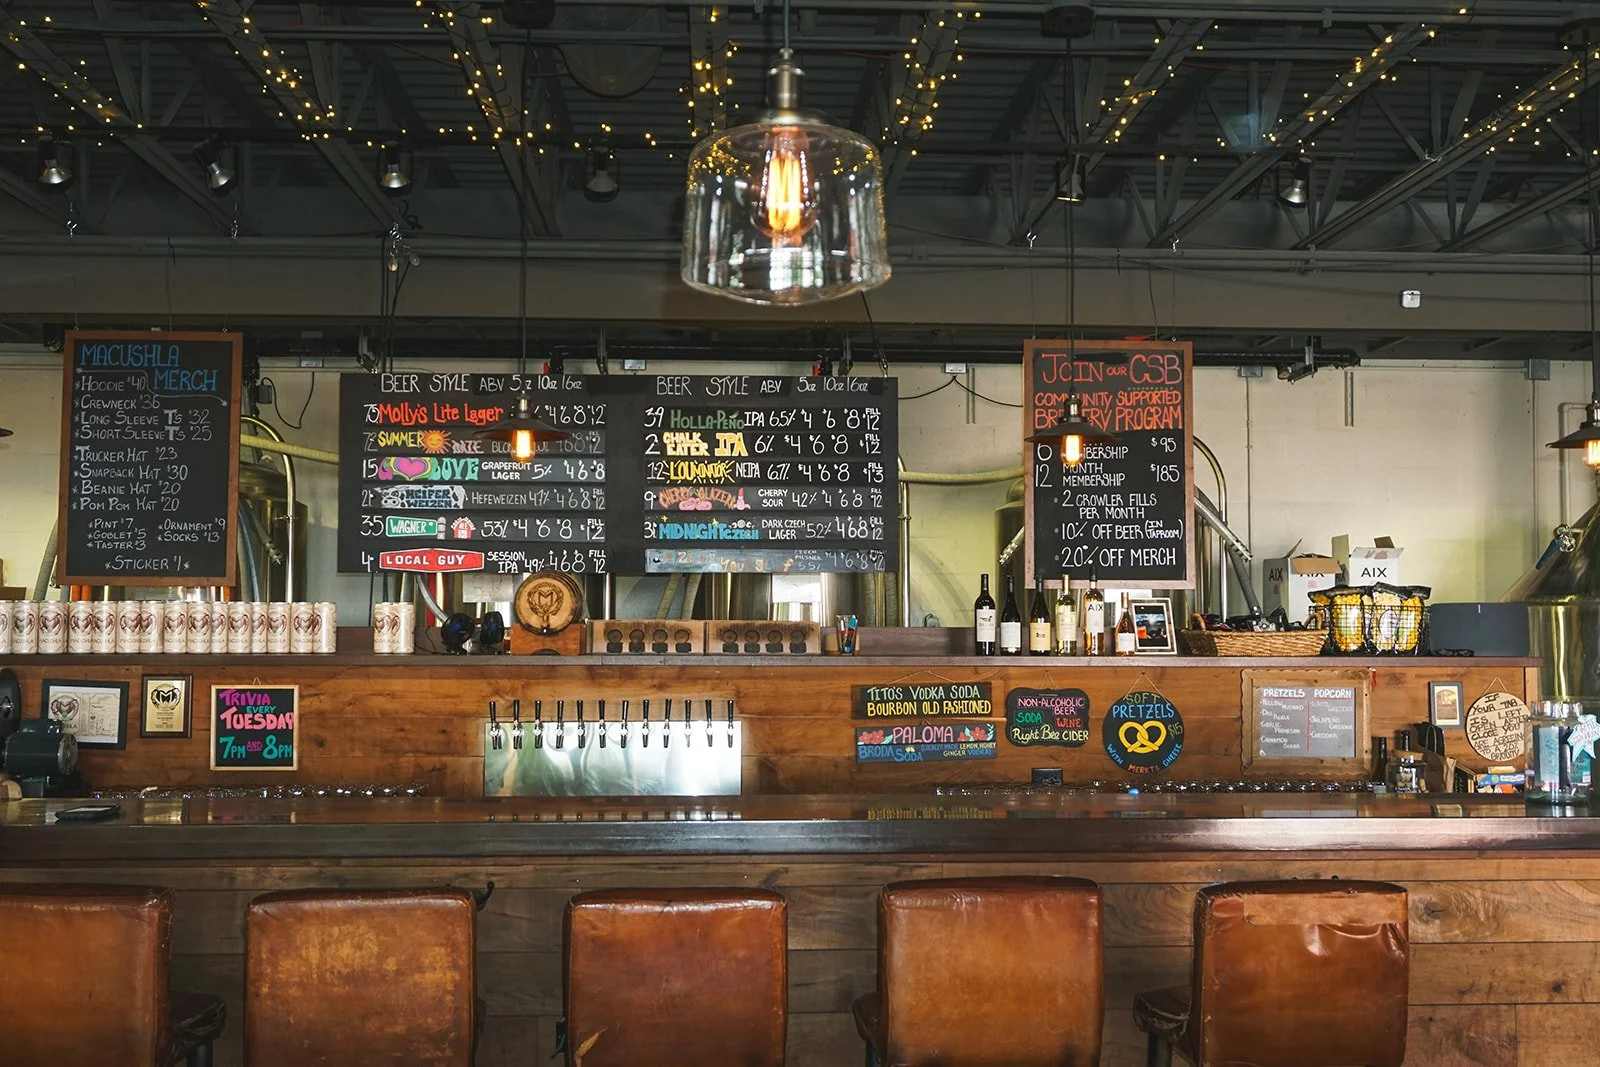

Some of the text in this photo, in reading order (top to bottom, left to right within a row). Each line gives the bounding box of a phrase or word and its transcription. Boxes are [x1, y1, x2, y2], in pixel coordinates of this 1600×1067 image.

[80, 344, 179, 367] MACUSHLA
[1042, 354, 1182, 384] JOIN OUR CSB
[81, 376, 145, 391] HOODIE $40
[153, 369, 217, 391] MERCH
[382, 374, 420, 392] BEER
[430, 373, 469, 392] STYLE
[480, 377, 504, 391] ABV
[657, 376, 692, 395] BEER
[706, 376, 749, 396] STYLE
[760, 380, 781, 393] ABV
[81, 394, 160, 409] CREWNECK $36
[1116, 391, 1181, 406] SUPPORTED
[81, 413, 110, 424] LONG
[115, 411, 159, 424] SLEEVE
[433, 403, 459, 423] Lite
[464, 402, 504, 426] Lager
[744, 412, 764, 427] IPA
[1116, 406, 1182, 431] PROGRAM
[80, 425, 122, 440] SHORT
[122, 427, 165, 440] SLEEVE
[378, 431, 424, 447] SUMMER
[663, 432, 774, 456] CHALK IPA 6%
[667, 443, 710, 456] EATER
[1151, 437, 1176, 453] $95
[75, 446, 124, 462] TRUCKER
[127, 449, 148, 461] HAT
[80, 464, 188, 479] SNAPBACK HAT $30
[482, 462, 531, 470] GRAPEFRUIT
[736, 463, 760, 478] NEIPA
[492, 471, 520, 479] LAGER
[1036, 463, 1179, 487] 12 MONTH $185
[1063, 473, 1125, 486] MEMBERSHIP
[81, 481, 181, 494] BEANIE HAT $20
[406, 489, 526, 504] HEIFER HEFEWEIZEN
[1062, 490, 1157, 506] 2 GROWLER FILLS
[80, 498, 179, 511] POM POM HAT $20
[1080, 508, 1144, 519] PER MONTH
[94, 519, 117, 529] PINT
[163, 519, 212, 531] ORNAMENT
[390, 519, 426, 533] WAGNER
[659, 520, 806, 539] MIDNIGHT CZECH DARK CZECH
[1062, 522, 1143, 539] 10% OFF BEER
[93, 531, 131, 539] GOBLET
[164, 532, 198, 541] SOCKS
[769, 530, 796, 539] LAGER
[95, 541, 133, 549] TASTER
[112, 555, 168, 570] STICKER
[387, 551, 525, 564] LOCAL GUY SESSION
[1062, 546, 1176, 567] 20% OFF MERCH
[498, 562, 518, 573] IPA
[1269, 568, 1282, 580] AIX
[1361, 568, 1387, 577] AIX
[219, 689, 270, 705] TRIVIA
[867, 685, 980, 701] TITO'S VODKA SODA
[1126, 693, 1160, 704] SOFT
[1264, 689, 1305, 697] PRETZELS
[1314, 689, 1351, 698] POPCORN
[1485, 693, 1500, 703] IF
[868, 700, 991, 716] BOURBON OLD FASHIONED
[1018, 699, 1084, 707] NON-ALCOHOLIC
[1112, 703, 1174, 718] PRETZELS
[1473, 704, 1495, 715] YOUR
[220, 706, 294, 729] TUESDAY
[1016, 712, 1080, 728] SODA WINE
[1470, 708, 1521, 725] IS LEFT
[1012, 724, 1088, 743] Right Bee CIDER
[1470, 721, 1497, 732] OPEN
[1502, 723, 1520, 734] YOU
[893, 726, 953, 744] PALOMA
[220, 735, 292, 759] 7PM AND 8PM
[858, 746, 894, 758] BRODA
[894, 748, 922, 761] SODA
[1108, 744, 1182, 766] WITH CHEESE
